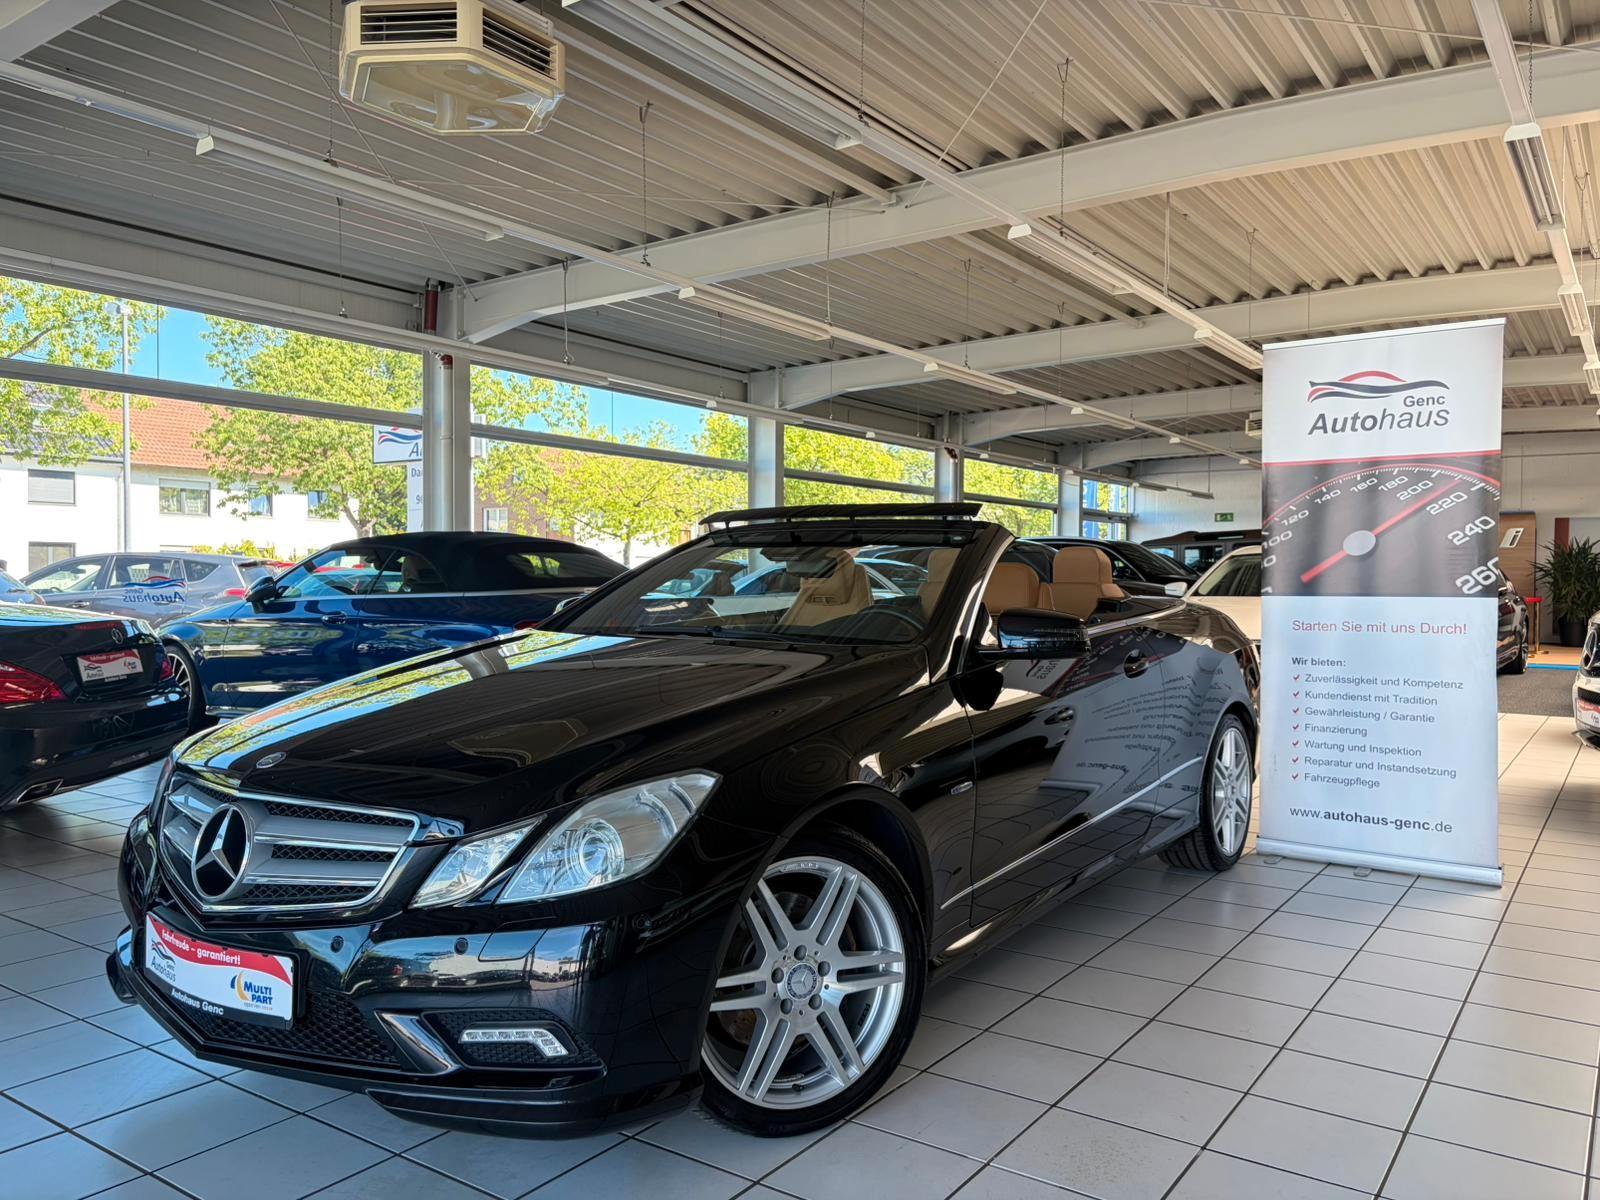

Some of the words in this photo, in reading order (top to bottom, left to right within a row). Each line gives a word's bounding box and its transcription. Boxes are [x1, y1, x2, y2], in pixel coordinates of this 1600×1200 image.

[1403, 395, 1446, 408] Genc
[1308, 408, 1450, 435] Autohaus
[1350, 477, 1378, 493] 160
[1378, 475, 1409, 492] 180
[1396, 480, 1433, 501] 200
[1314, 489, 1342, 505] 140
[1426, 491, 1468, 515] 220
[1281, 509, 1309, 526] 120
[1447, 516, 1496, 546] 240
[1292, 619, 1337, 632] Starten
[1341, 620, 1363, 632] Sie
[1366, 621, 1386, 633] mit
[1391, 623, 1416, 634] uns
[1420, 622, 1467, 635] Durch!
[1291, 656, 1308, 666] Wir
[1311, 657, 1346, 667] bieten:
[1304, 673, 1378, 687] Zuverlässigkeit
[1381, 676, 1400, 686] und
[1403, 678, 1464, 690] Kompetenz
[1304, 690, 1372, 702] Kundendienst
[1374, 693, 1390, 703] mit
[1393, 694, 1438, 705] Tradition
[1304, 706, 1381, 721] Gewährleistung
[1390, 712, 1435, 723] Garantie
[1304, 723, 1368, 737] Finanzierung
[1304, 740, 1345, 753] Wartung
[1347, 743, 1366, 753] und
[1369, 744, 1422, 757] Inspektion
[1304, 756, 1353, 770] Reparatur
[1355, 760, 1374, 770] und
[1377, 762, 1457, 779] Instandsetzung
[1304, 772, 1381, 789] Fahrzeugpflege
[1289, 806, 1453, 833] www.autohaus-genc.de
[197, 948, 241, 965] garantiert!
[244, 981, 272, 995] MULTI
[171, 988, 200, 1008] Autohaus
[202, 1002, 224, 1016] Genc
[252, 994, 273, 1005] PART
